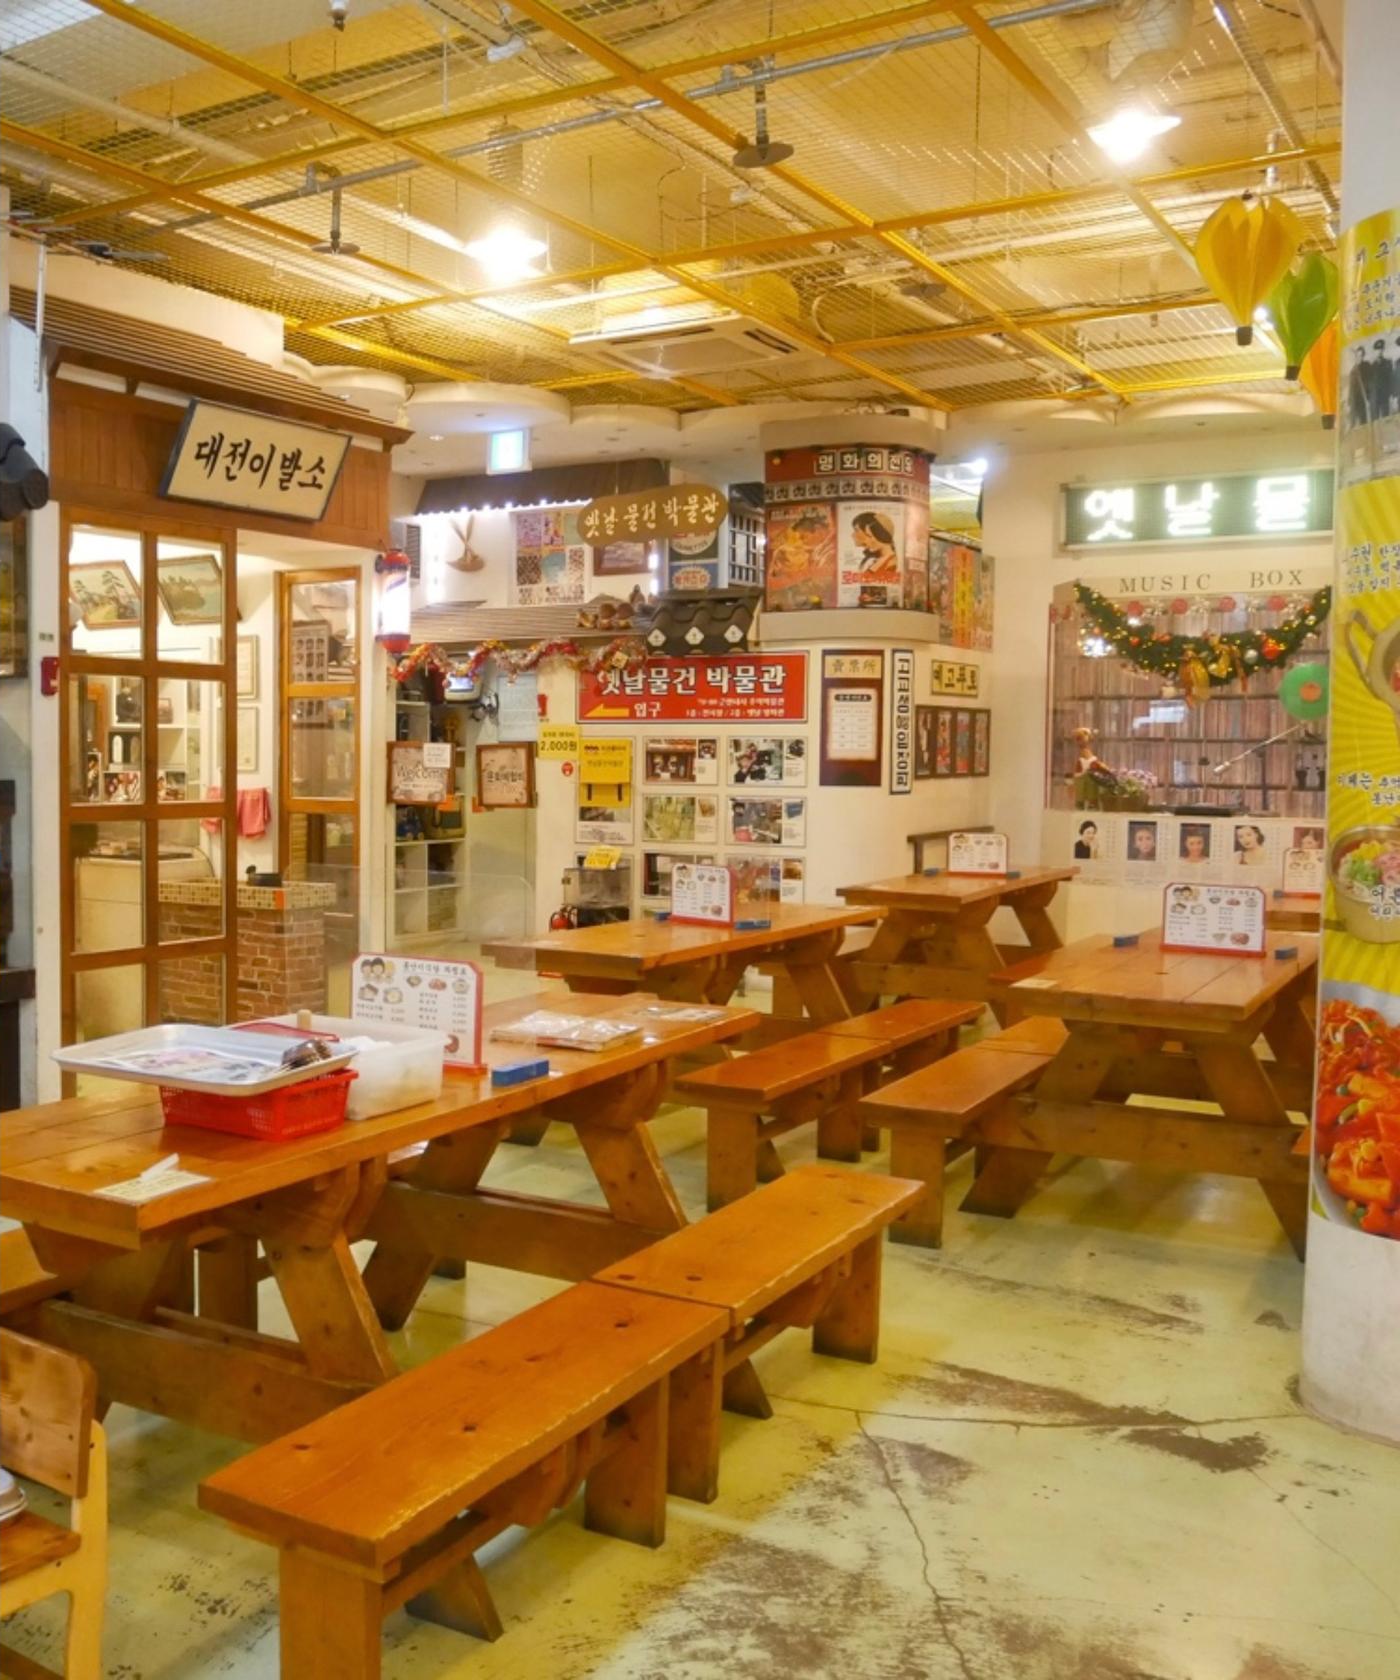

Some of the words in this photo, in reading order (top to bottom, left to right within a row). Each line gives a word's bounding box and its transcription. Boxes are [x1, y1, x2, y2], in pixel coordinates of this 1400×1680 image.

[194, 432, 326, 491] 대전이발소
[584, 508, 618, 538] 옛날
[623, 501, 657, 533] 물건
[662, 493, 720, 527] 박물관
[1119, 573, 1212, 594] MUSIC
[1250, 569, 1303, 588] BOX
[596, 666, 697, 695] 옛날물건
[706, 665, 787, 694] 박물관
[634, 702, 662, 718] 입구
